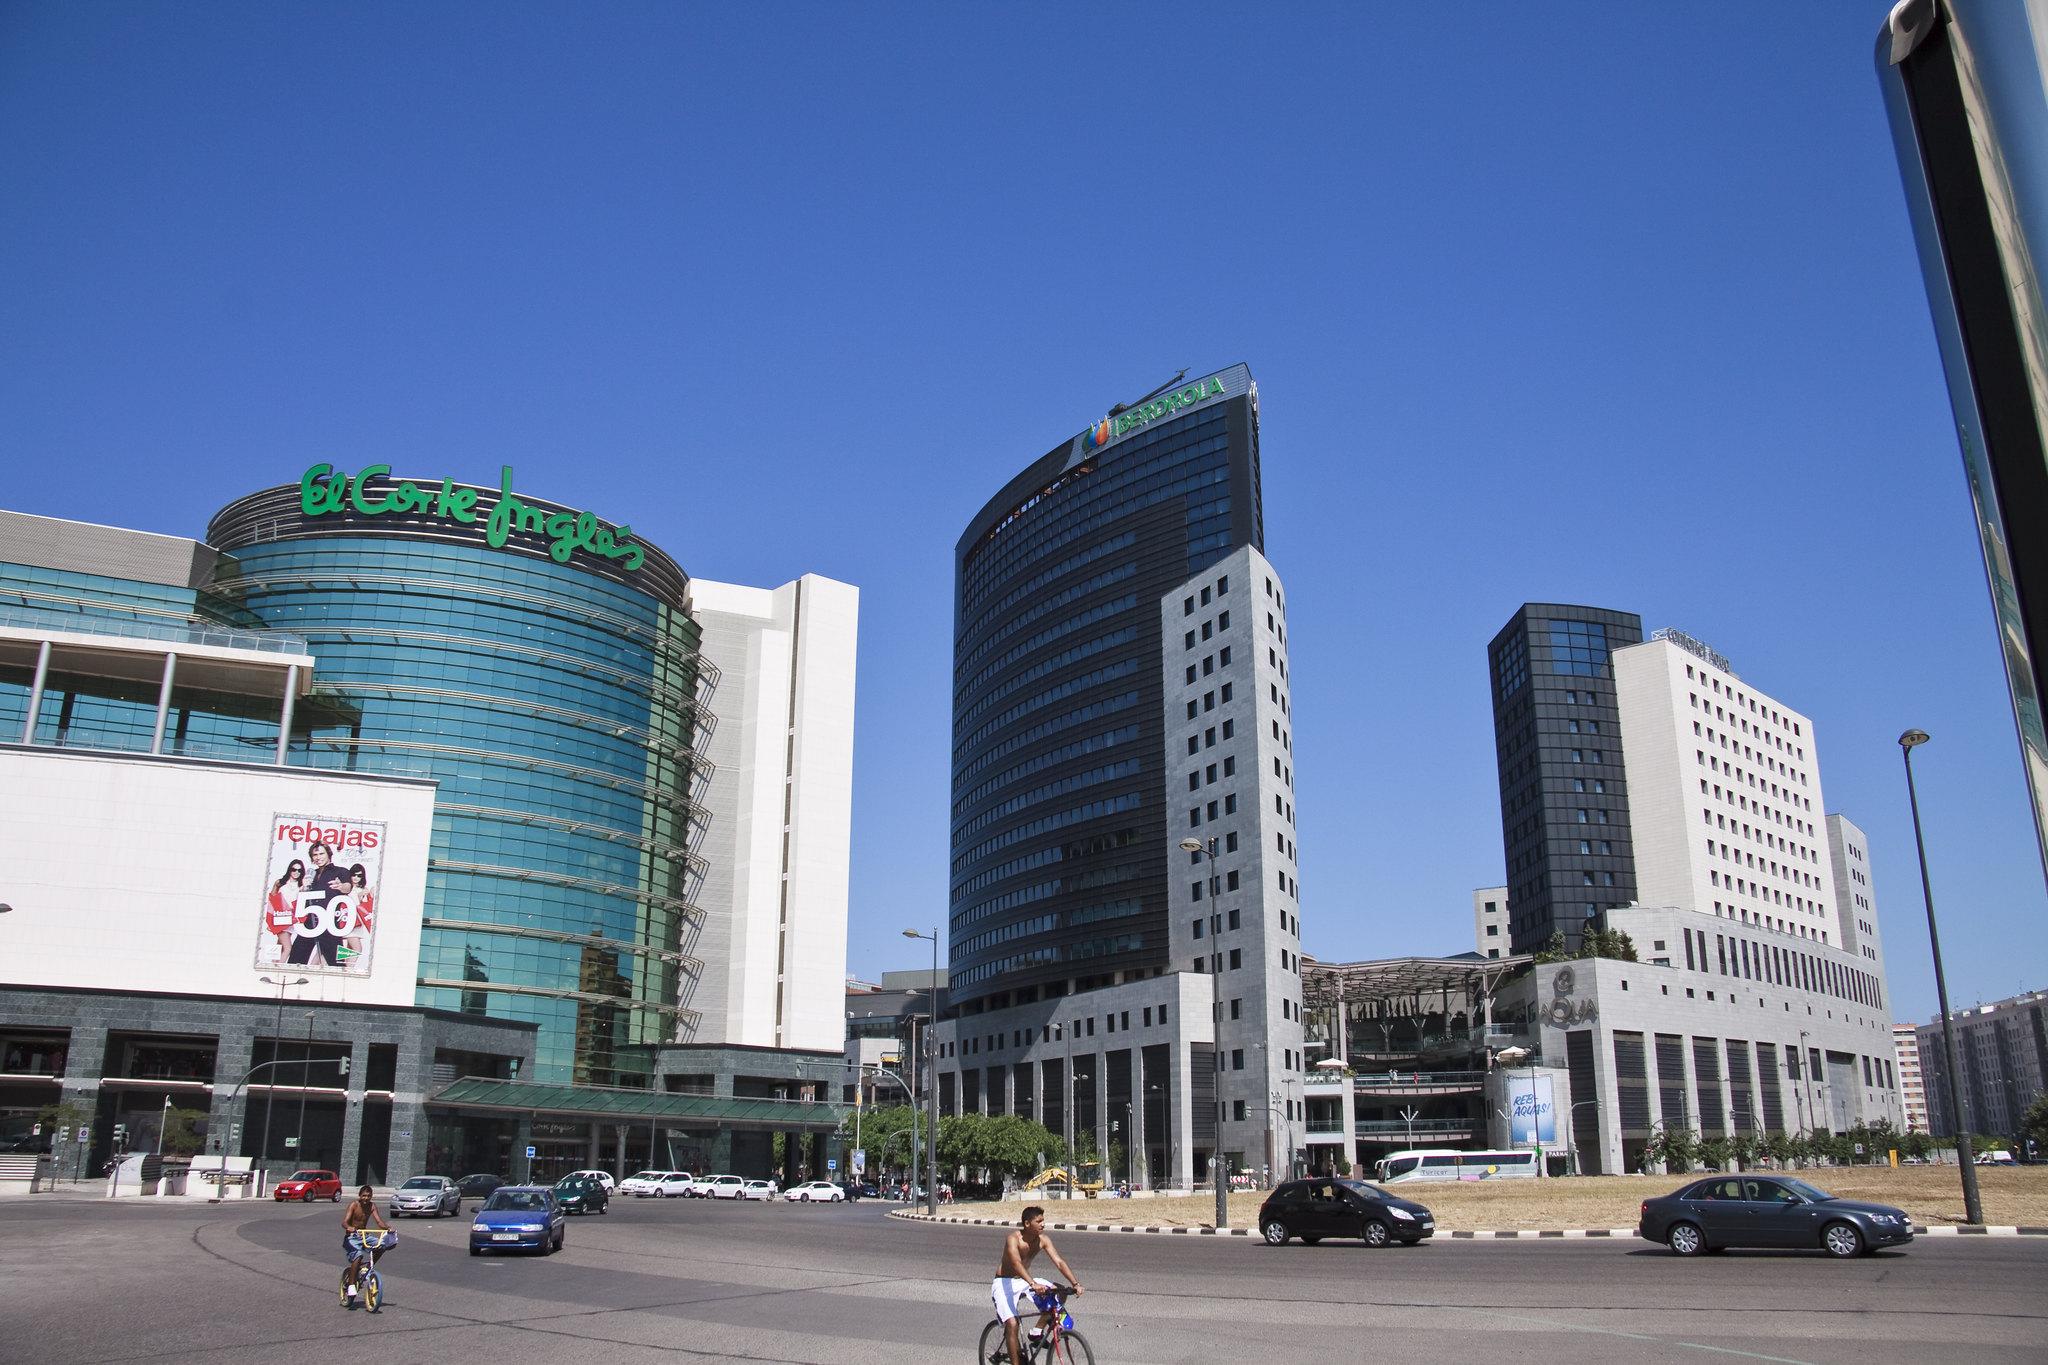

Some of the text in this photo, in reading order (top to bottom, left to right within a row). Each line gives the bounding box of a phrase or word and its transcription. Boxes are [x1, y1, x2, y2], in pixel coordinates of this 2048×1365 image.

[1112, 377, 1225, 437] IBERDROLA
[301, 463, 645, 571] El Corte Inglés
[278, 821, 378, 850] rebajas
[1540, 997, 1600, 1023] AQUA
